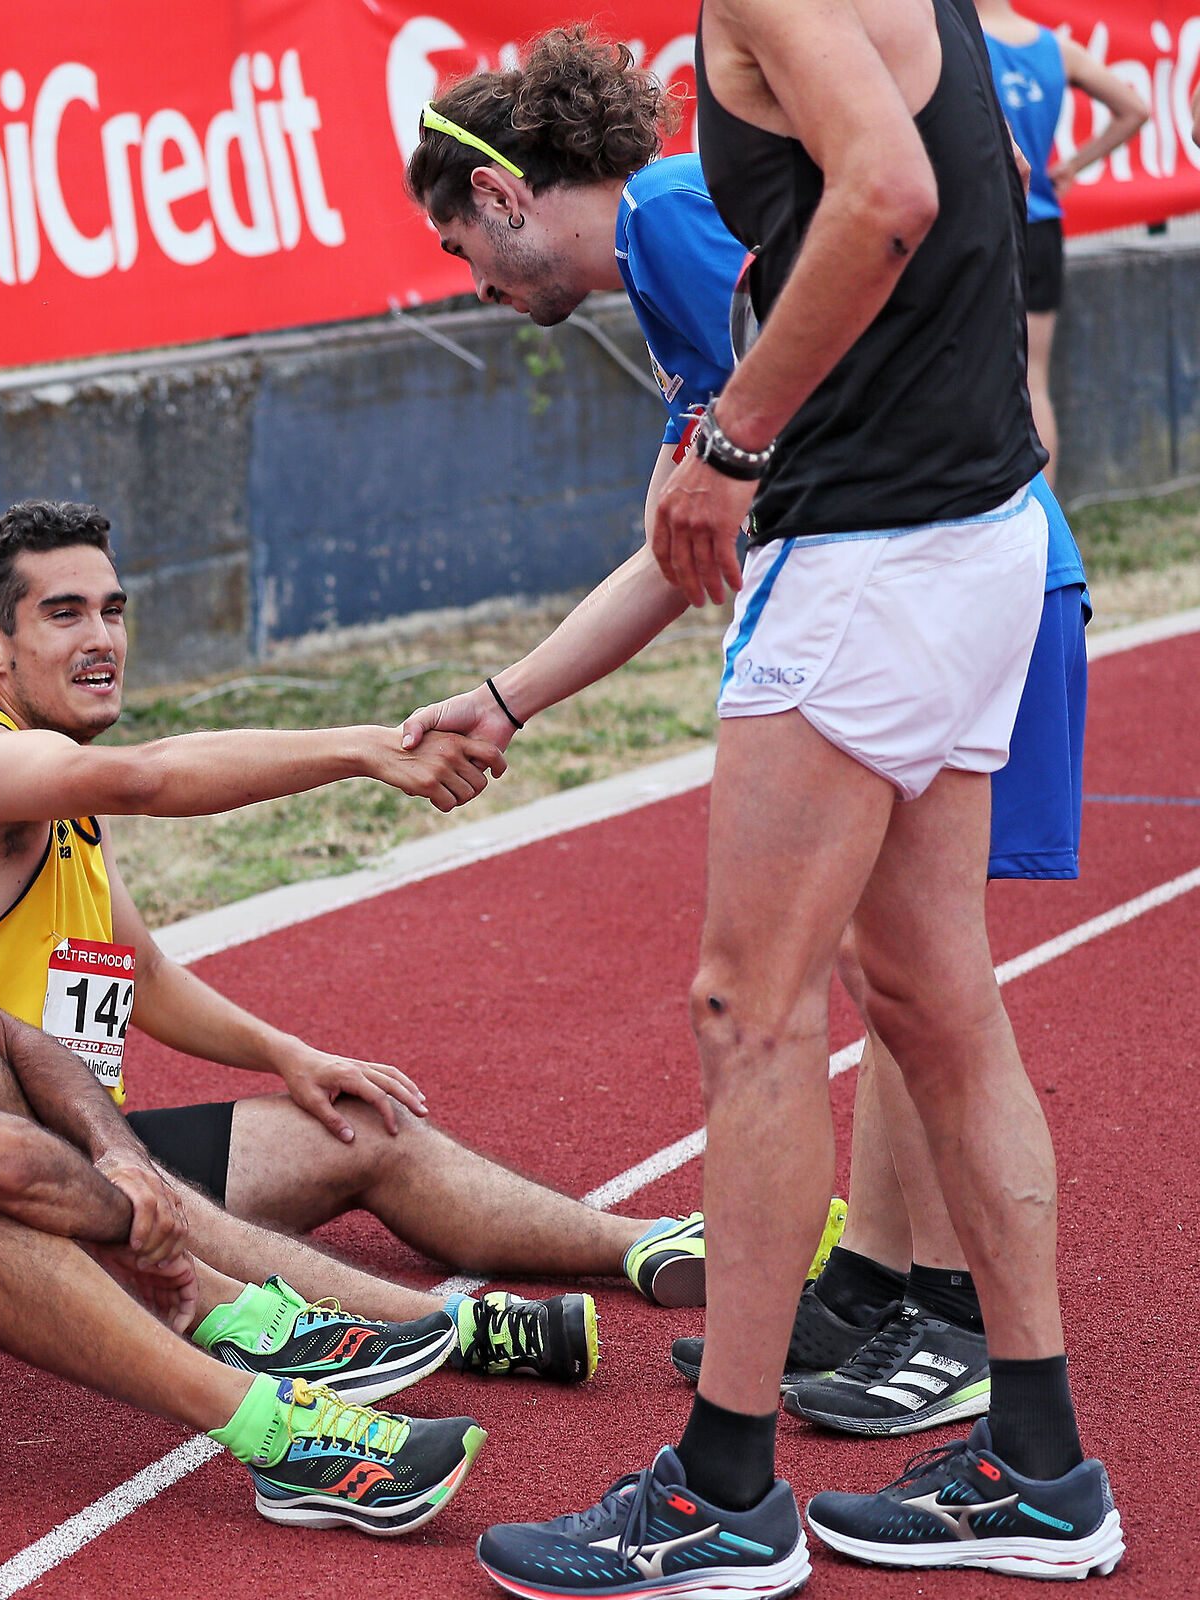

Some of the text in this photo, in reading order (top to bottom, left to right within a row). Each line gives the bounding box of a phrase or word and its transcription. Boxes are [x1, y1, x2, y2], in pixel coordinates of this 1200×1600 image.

[752, 666, 805, 685] asics
[66, 977, 133, 1039] 142
[100, 1044, 123, 1056] 2021
